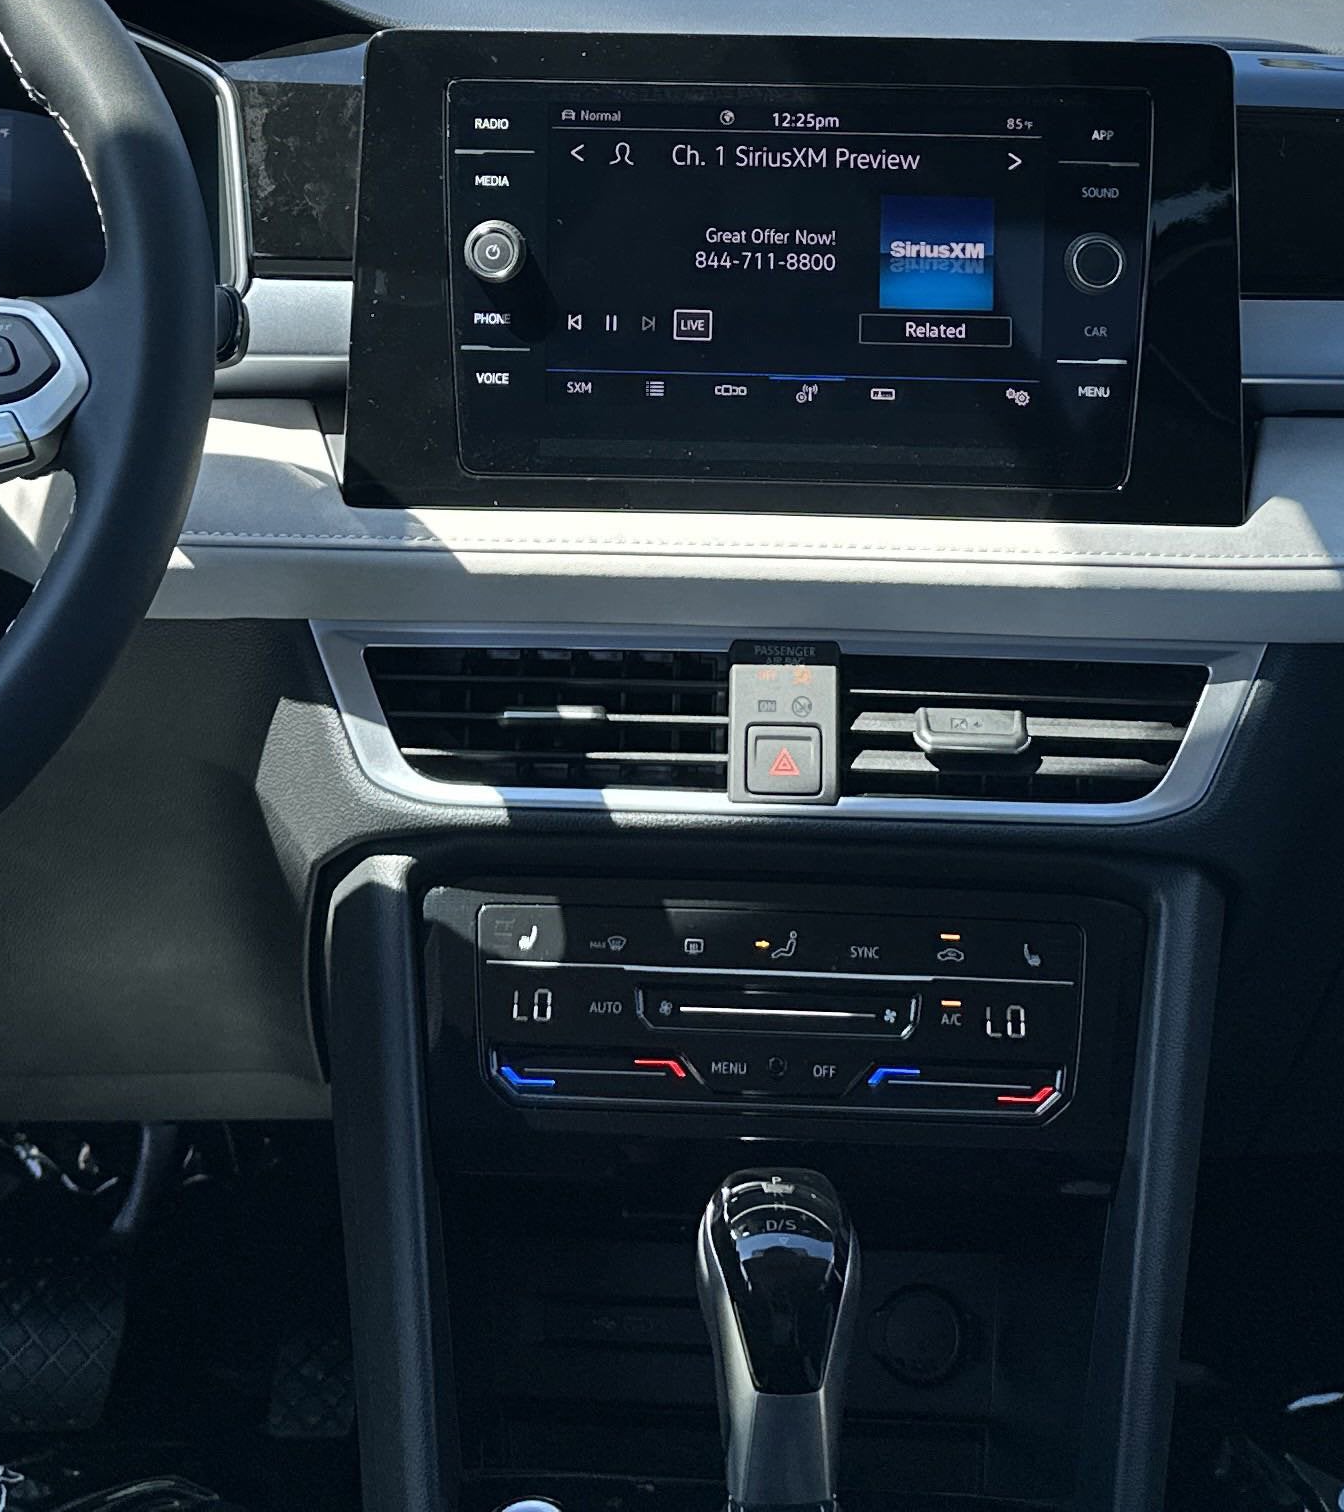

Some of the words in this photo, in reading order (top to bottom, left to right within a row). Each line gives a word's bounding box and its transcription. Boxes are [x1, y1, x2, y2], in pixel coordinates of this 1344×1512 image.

[474, 117, 509, 130] RADIO
[580, 109, 622, 124] Normal
[772, 112, 840, 132] 12:25pm
[1091, 129, 1114, 141] APP
[672, 143, 706, 167] Ch.
[716, 145, 725, 166] 1
[735, 144, 828, 169] SiriusXM
[835, 146, 921, 171] Preview
[474, 175, 510, 187] MEDIA
[1081, 186, 1120, 199] SOUND
[705, 226, 745, 245] Great
[747, 227, 790, 246] Offer
[794, 228, 837, 247] Now!
[889, 239, 985, 260] SiriusXM
[694, 250, 836, 273] 844-711-8800
[473, 312, 511, 325] PHONE
[680, 319, 705, 331] LIVE
[904, 320, 966, 340] Related
[1083, 325, 1108, 337] CAR
[475, 372, 510, 385] VOICE
[566, 381, 592, 394] SXM
[1077, 385, 1111, 398] MENU
[753, 644, 817, 658] PASSENGER
[759, 701, 775, 712] ON
[850, 945, 879, 959] SYNC
[512, 988, 553, 1022] LO
[589, 1001, 623, 1015] AUTO
[940, 1013, 962, 1027] A/C
[985, 1005, 1026, 1038] LO
[711, 1061, 747, 1075] MENU
[812, 1064, 836, 1078] OFF
[765, 1219, 797, 1231] D/S
